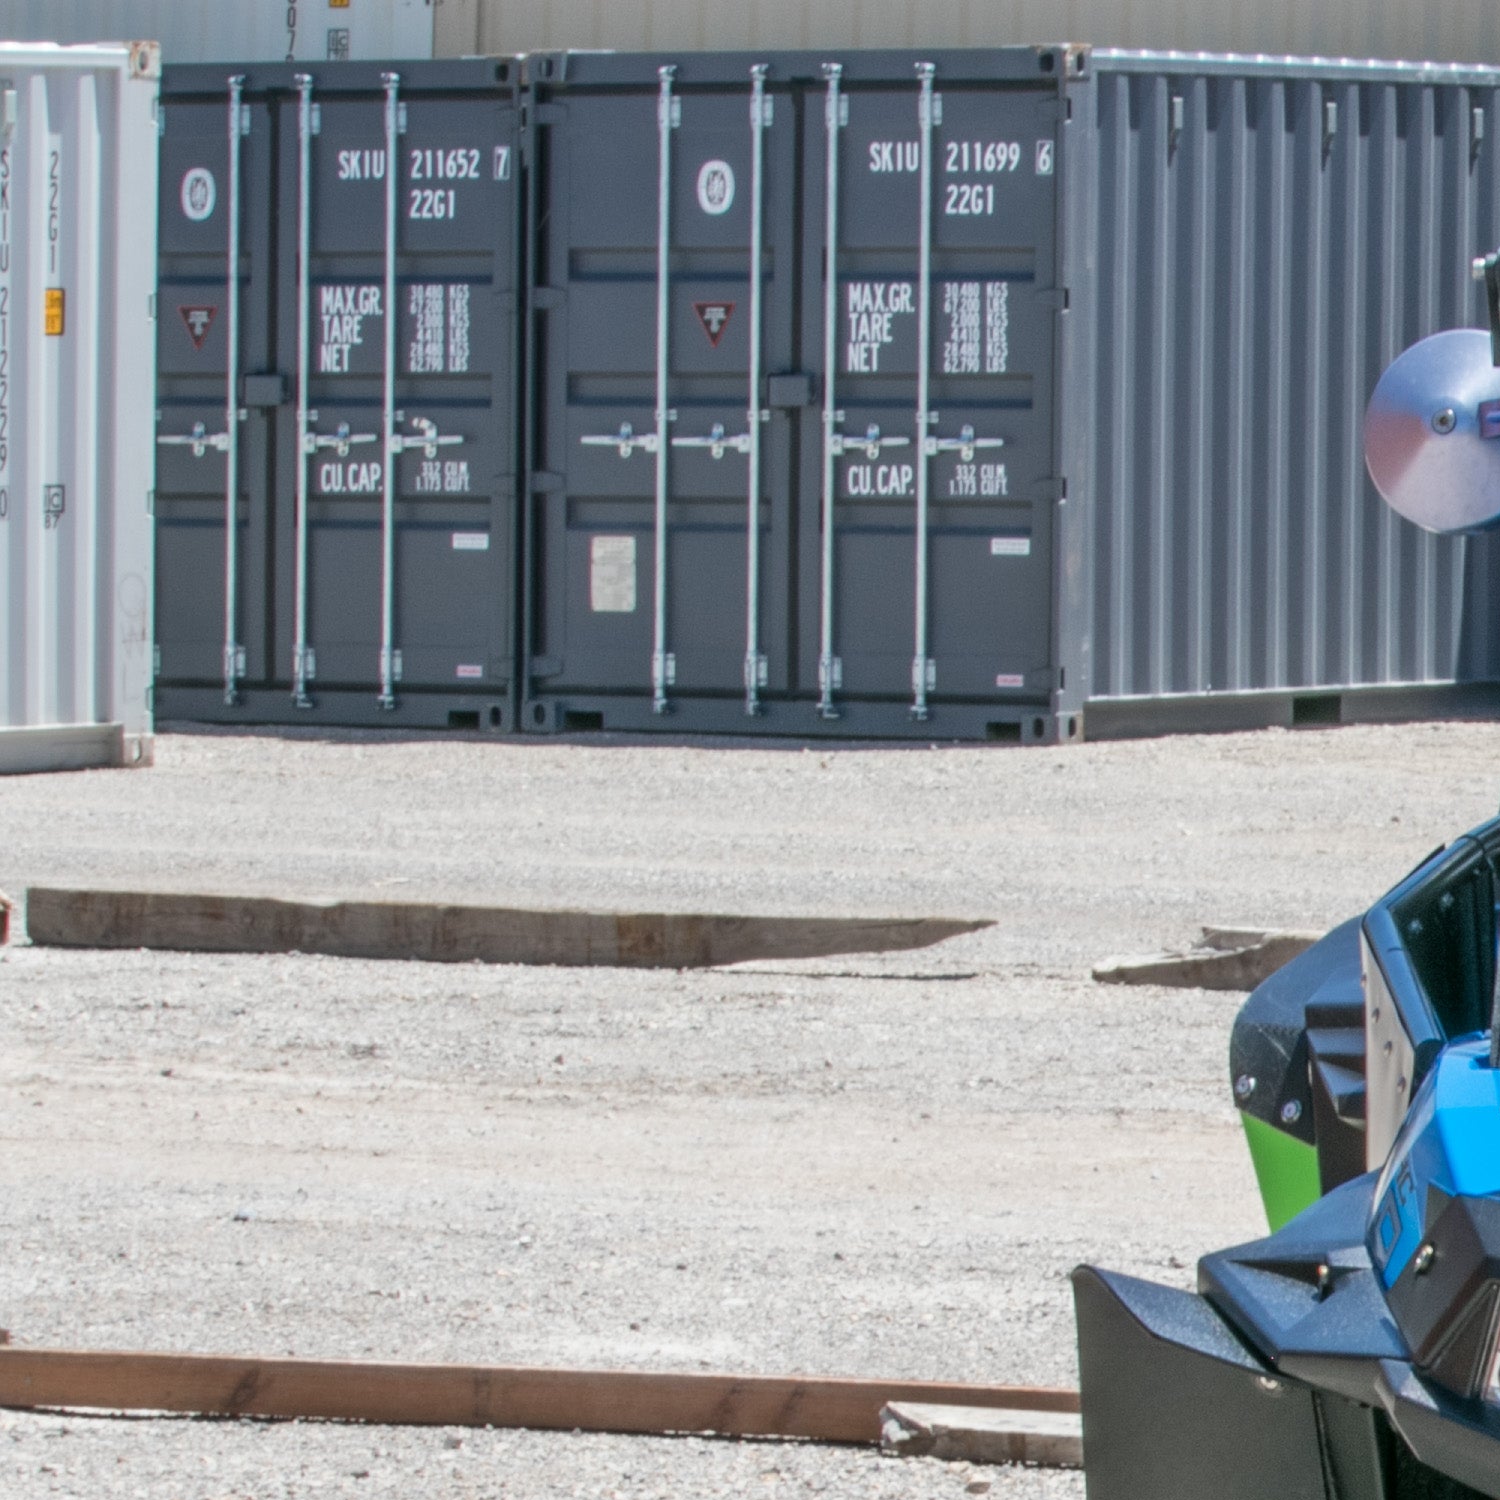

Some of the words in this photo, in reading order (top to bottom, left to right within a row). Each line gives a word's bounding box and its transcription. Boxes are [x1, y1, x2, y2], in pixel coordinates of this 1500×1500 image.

[338, 150, 385, 179] SKIU
[410, 149, 480, 179] 211652
[495, 148, 510, 180] 7
[869, 142, 919, 172] SKIU
[946, 142, 1020, 172] 211699
[1037, 140, 1053, 174] 6
[49, 150, 58, 274] 22G1
[410, 189, 455, 219] 22G1
[945, 185, 994, 215] 22G1
[320, 286, 383, 315] MAX.GR.
[848, 283, 915, 312] MAX.GR.
[321, 315, 363, 344] TARE
[849, 313, 893, 342] TARE
[320, 344, 350, 372] NET
[848, 343, 880, 372] NET
[320, 463, 384, 492] CU.CAP.
[848, 465, 915, 495] CU.CAP.
